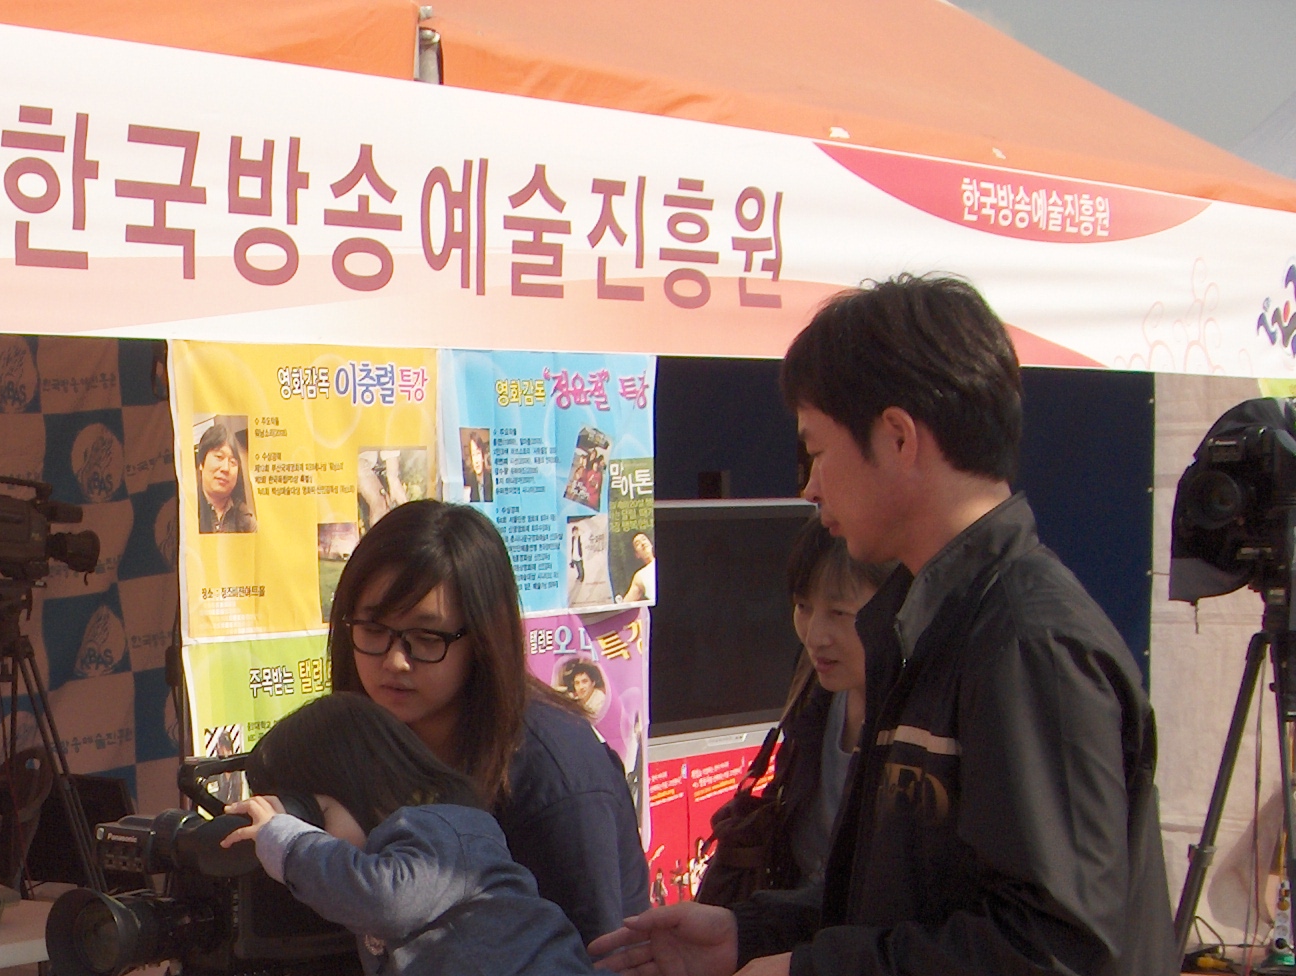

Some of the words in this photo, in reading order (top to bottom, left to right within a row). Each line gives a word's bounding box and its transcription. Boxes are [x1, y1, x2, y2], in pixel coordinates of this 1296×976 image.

[0, 105, 786, 310] 한국방송예술진흥원
[961, 177, 1111, 236] 한국방송예술진흥원
[277, 365, 331, 401] 영화감독
[333, 360, 397, 406] 이충렬
[398, 367, 428, 402] 특강
[495, 379, 546, 407] 영화감독
[248, 665, 295, 698] 주목받는
